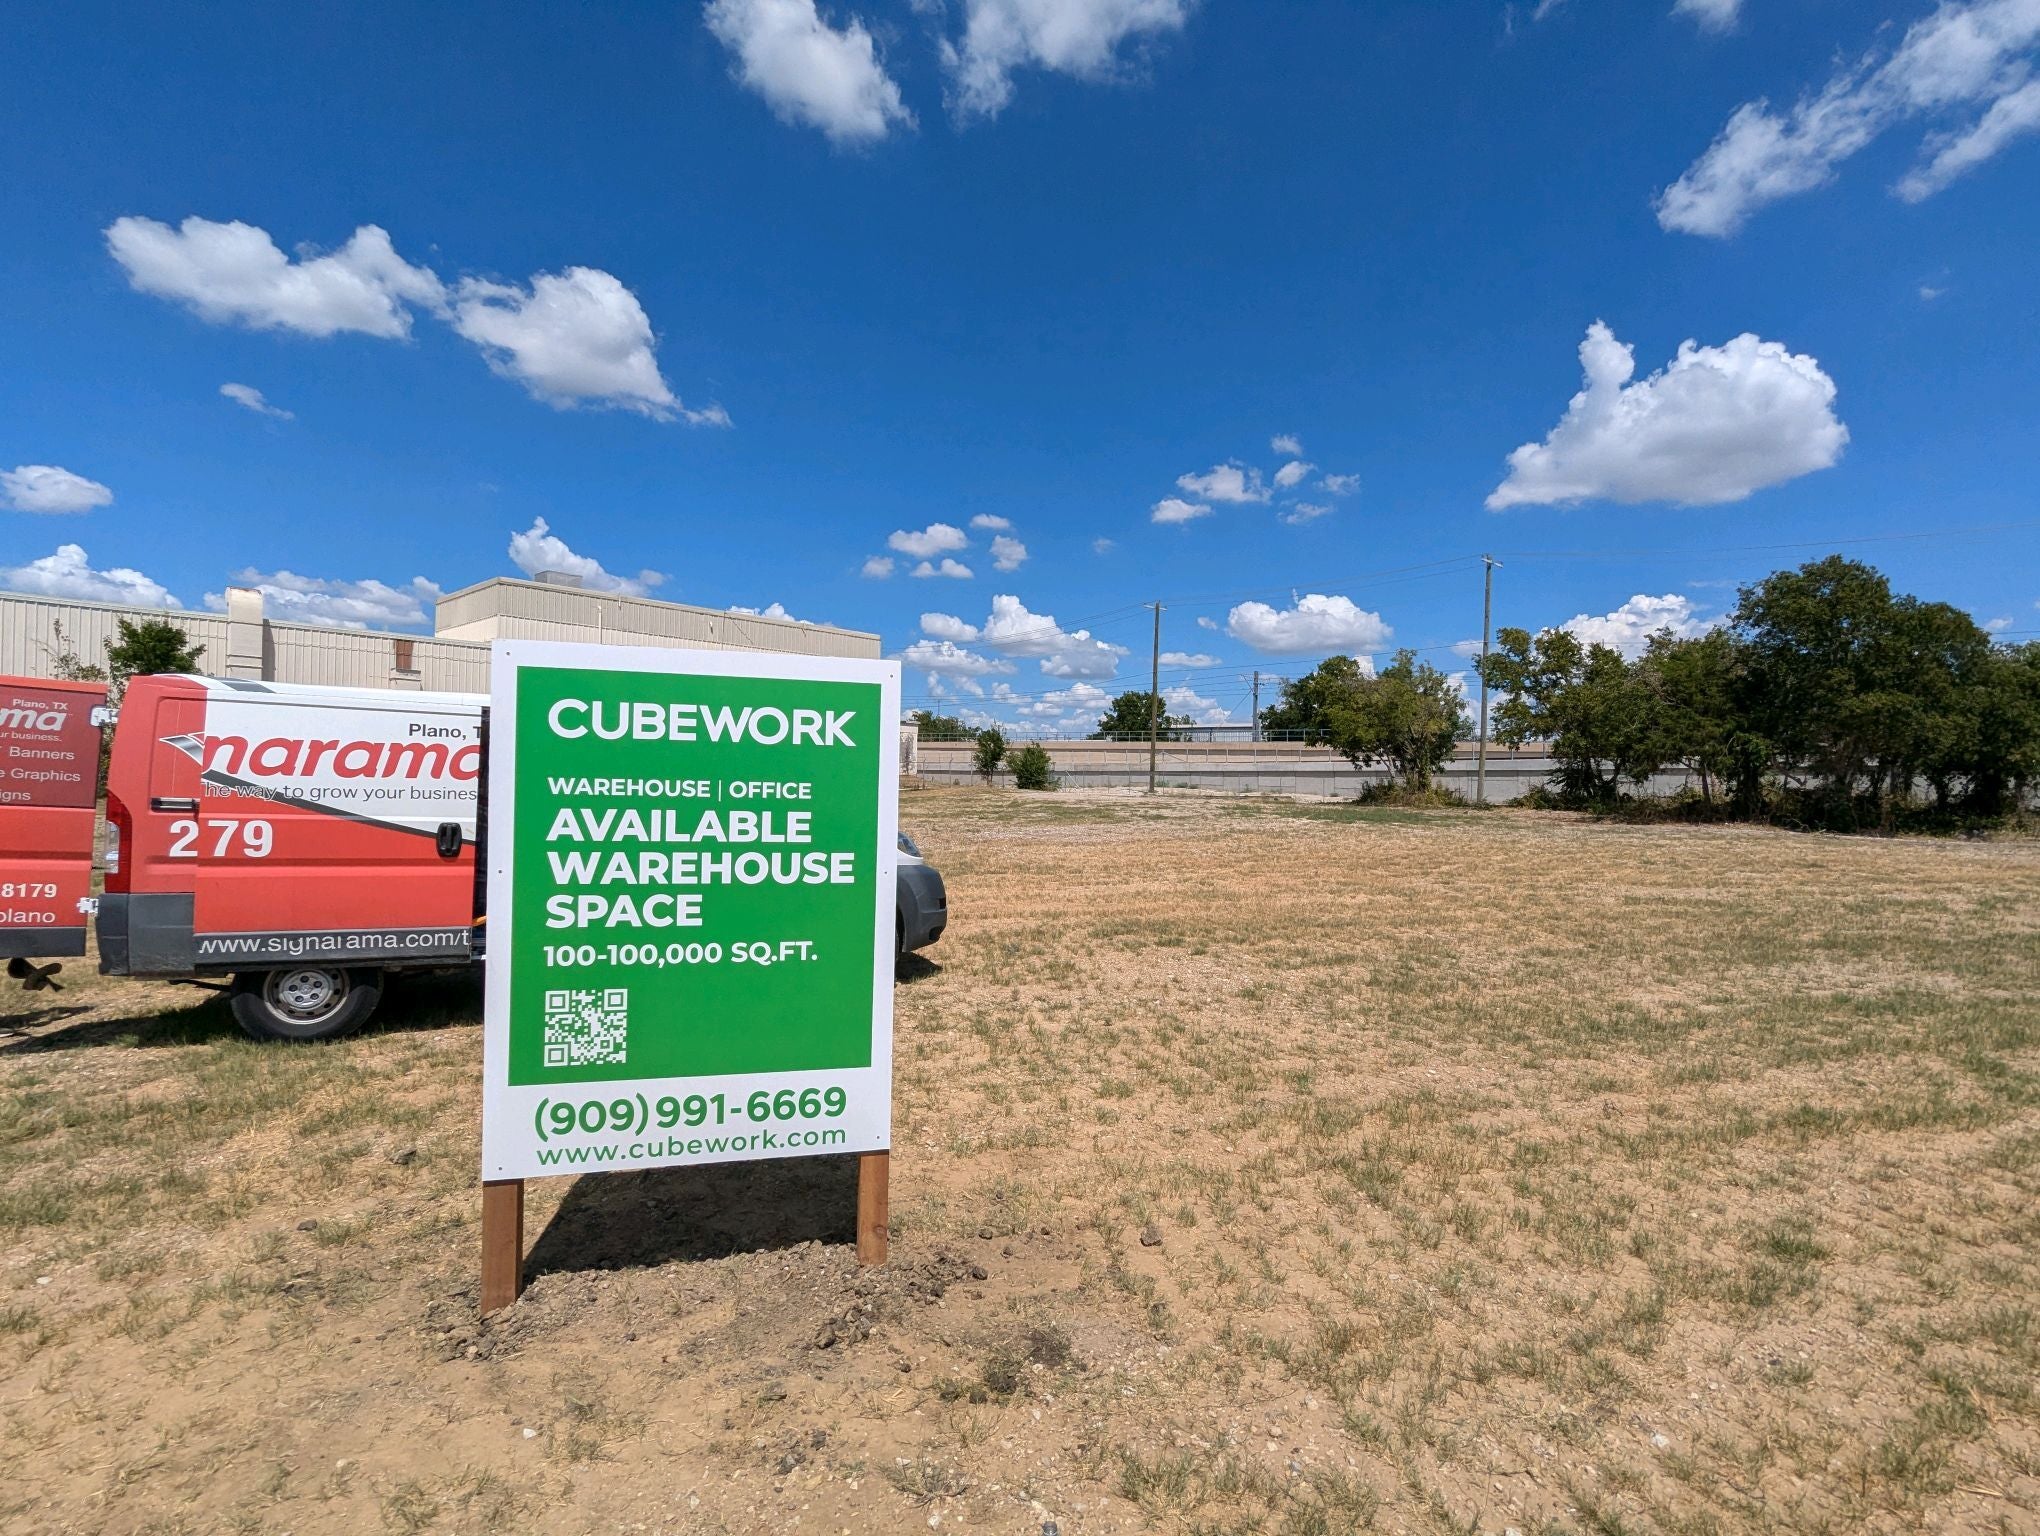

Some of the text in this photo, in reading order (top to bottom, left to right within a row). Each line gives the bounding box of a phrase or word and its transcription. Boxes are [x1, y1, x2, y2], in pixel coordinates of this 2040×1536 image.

[12, 698, 68, 710] Plano, TX
[409, 723, 467, 740] Plano,
[548, 699, 856, 747] CUBEWORK
[12, 731, 62, 742] business.
[10, 746, 75, 760] Banners
[11, 768, 81, 782] Graphics
[201, 781, 231, 798] he
[237, 784, 278, 802] way
[283, 785, 304, 799] to
[310, 786, 359, 802] grow
[363, 787, 405, 802] your
[547, 776, 812, 799] WAREHOUSE OFFICE
[546, 808, 812, 843] AVAILABLE
[547, 851, 855, 885] WAREHOUSE
[545, 894, 703, 928] SPACE
[544, 940, 818, 969] 100-100,000 SQ.FT.
[536, 1127, 846, 1166] www.cubework.com
